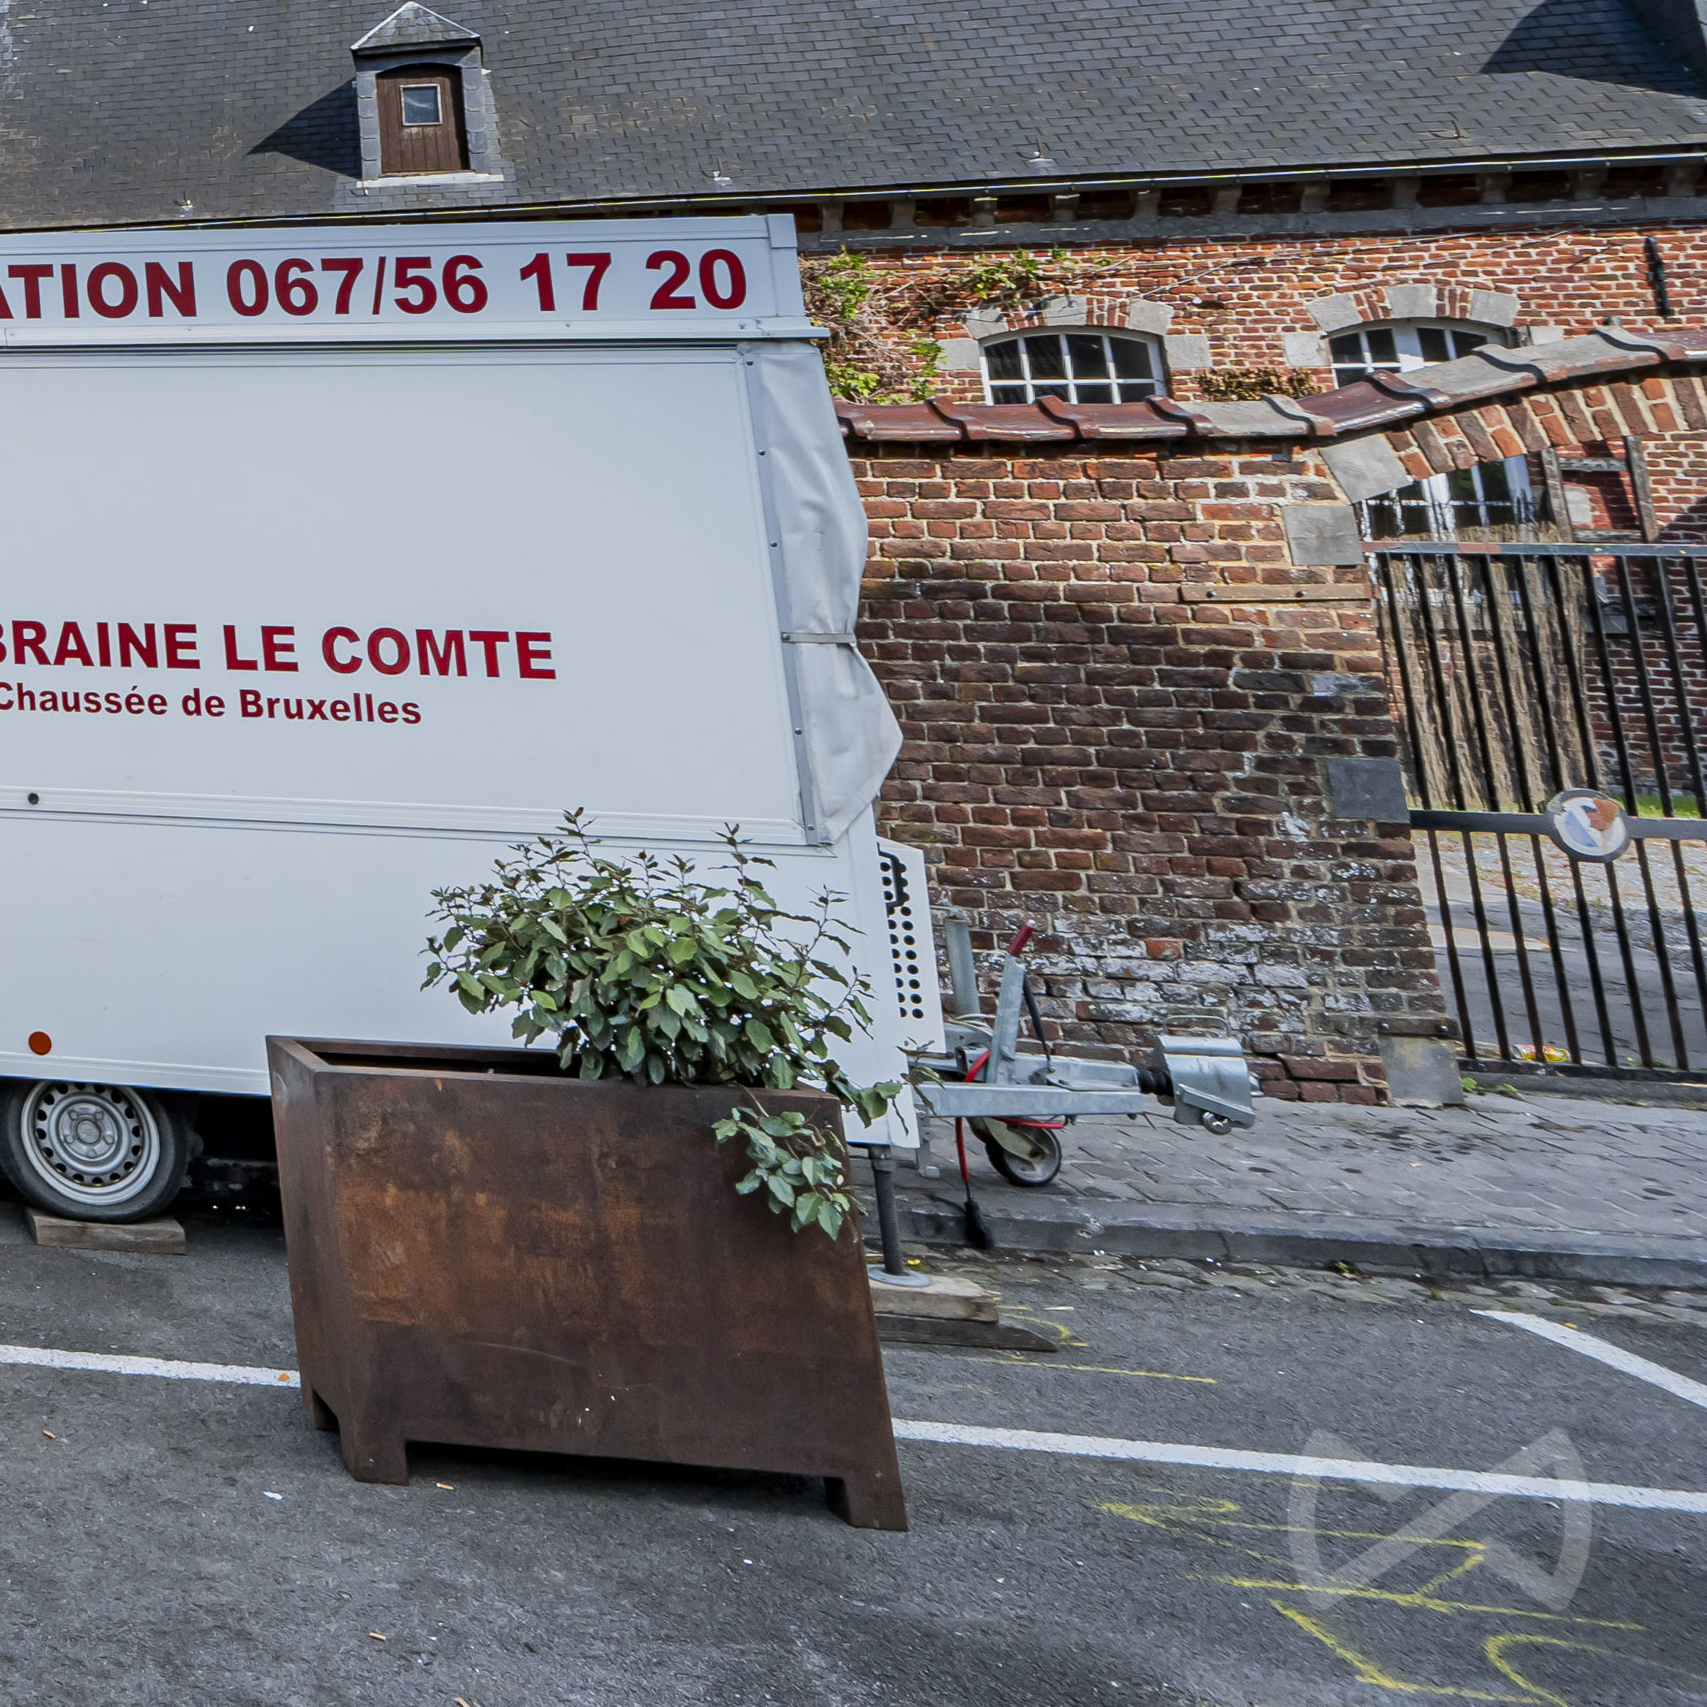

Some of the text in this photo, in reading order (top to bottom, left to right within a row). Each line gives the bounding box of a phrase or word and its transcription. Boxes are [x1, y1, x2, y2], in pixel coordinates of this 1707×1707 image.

[226, 254, 489, 318] 067/56
[519, 252, 613, 313] 17
[645, 248, 748, 312] 20
[222, 624, 299, 673] LE
[321, 626, 557, 680] COMTE
[181, 686, 225, 718] de
[239, 688, 422, 725] Bruxelles
